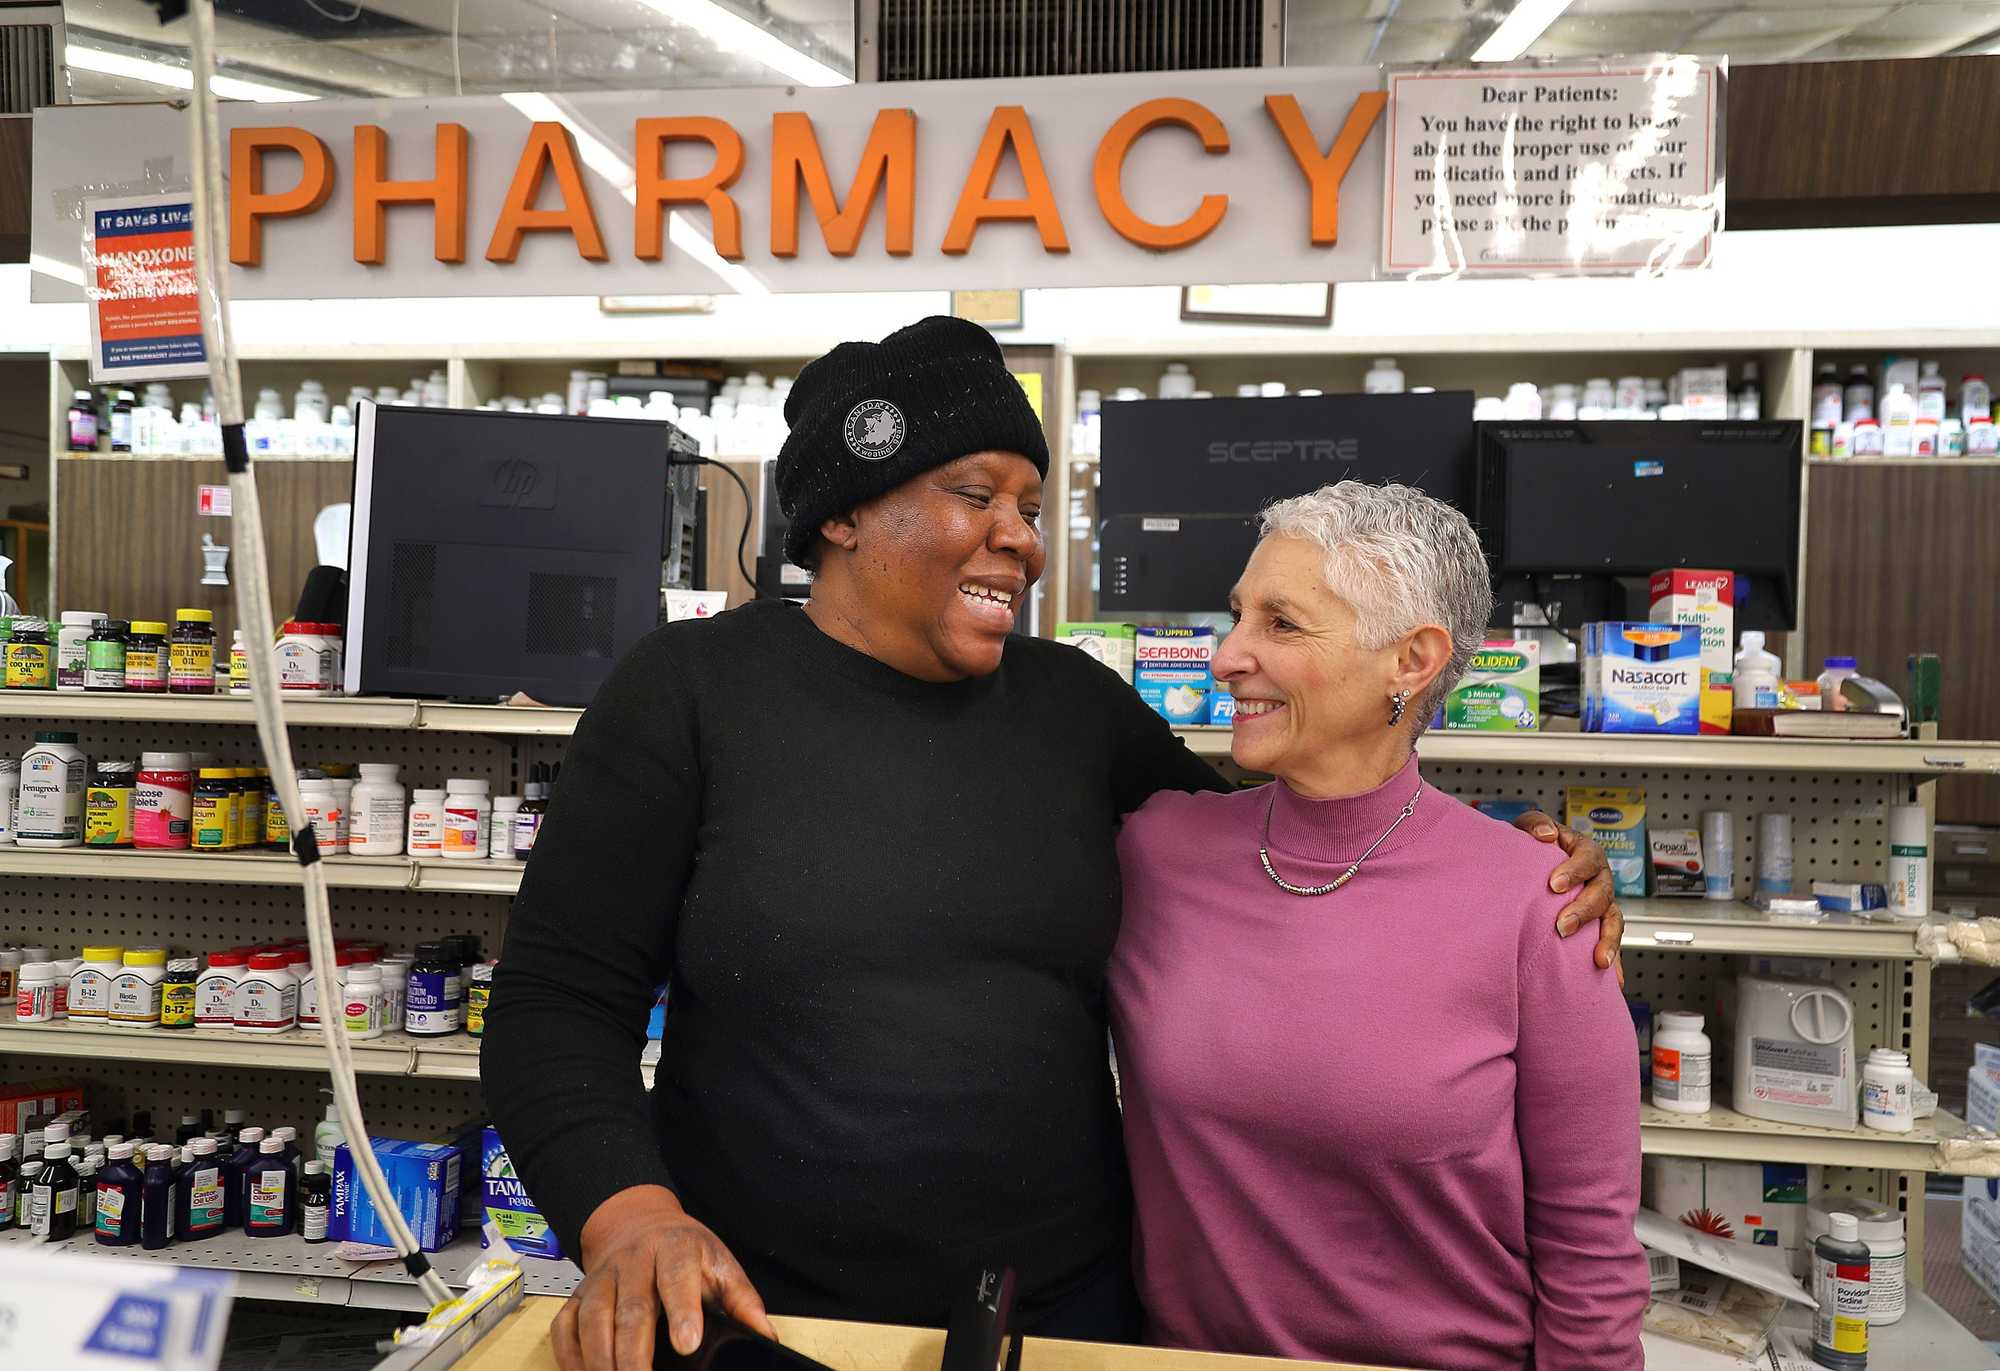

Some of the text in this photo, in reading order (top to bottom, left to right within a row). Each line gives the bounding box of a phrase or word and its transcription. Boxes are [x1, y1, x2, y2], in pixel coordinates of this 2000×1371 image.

[1482, 85, 1618, 103] Dear Patients:
[1421, 115, 1458, 132] You
[1465, 115, 1508, 132] have
[1515, 115, 1543, 132] the
[1550, 114, 1596, 136] right
[1603, 115, 1621, 130] to
[1413, 141, 1465, 157] abut
[1472, 141, 1500, 157] the
[1580, 142, 1610, 156] use
[1655, 140, 1687, 154] our
[230, 91, 1388, 267] PHARMACY
[1524, 164, 1559, 182] and
[1668, 161, 1688, 179] If
[1414, 193, 1436, 210] yo
[1455, 190, 1498, 207] need
[100, 217, 113, 230] IT
[1522, 214, 1552, 232] the
[848, 402, 881, 428] CANADA
[1208, 438, 1359, 463] SCEPTRE
[182, 657, 196, 665] OIL
[186, 648, 210, 657] LIVER
[1472, 655, 1521, 668] OLIDENT
[1612, 669, 1688, 686] Nasacort
[1473, 690, 1501, 698] Minute
[22, 783, 61, 794] Fenugreek
[136, 788, 164, 798] ucose
[136, 798, 159, 807] blets
[1592, 831, 1627, 841] ALLUS
[164, 1005, 186, 1014] B-12
[336, 1170, 345, 1217] TAMPAX
[485, 1180, 528, 1197] TAM
